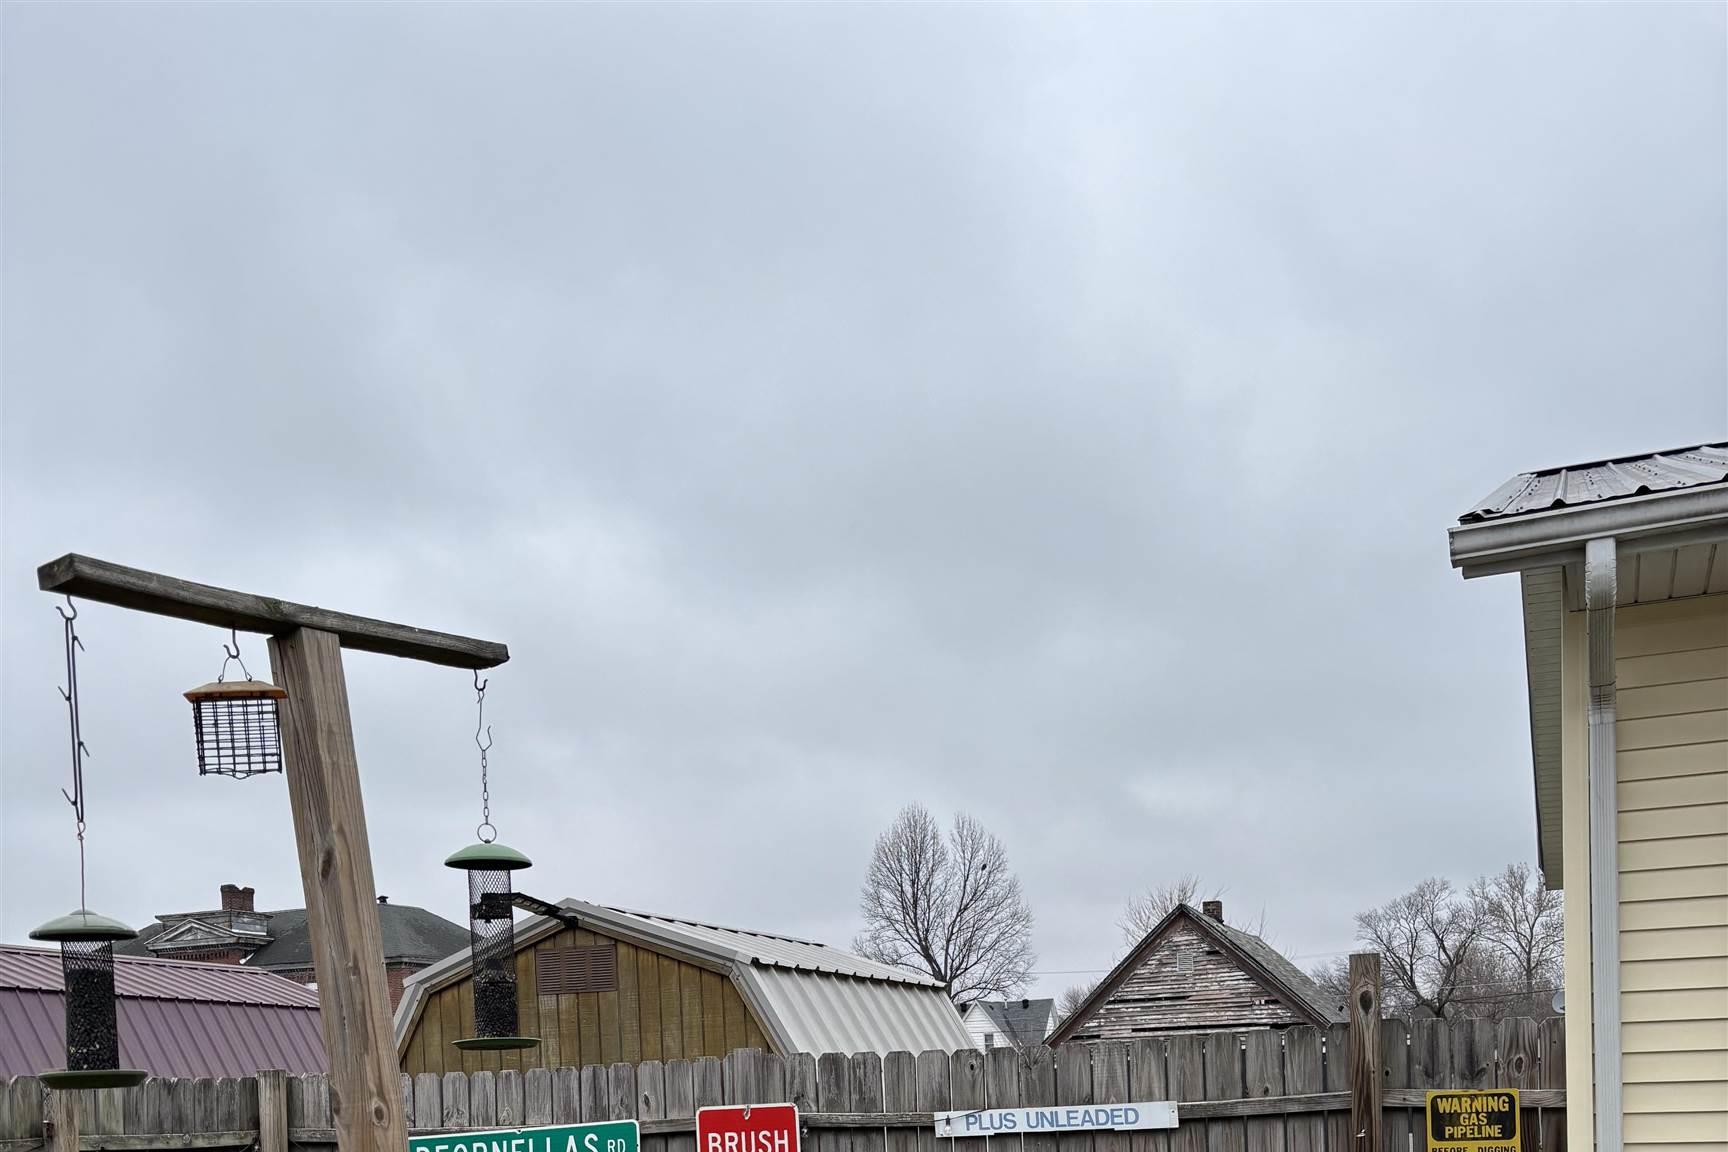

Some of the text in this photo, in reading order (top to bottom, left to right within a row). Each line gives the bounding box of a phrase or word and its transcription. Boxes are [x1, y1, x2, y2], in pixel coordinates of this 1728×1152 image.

[1437, 1096, 1509, 1113] WARNING
[965, 1107, 1140, 1131] PLUS UNLEADED
[1460, 1113, 1487, 1125] GAS
[1445, 1125, 1502, 1138] PIPELINE
